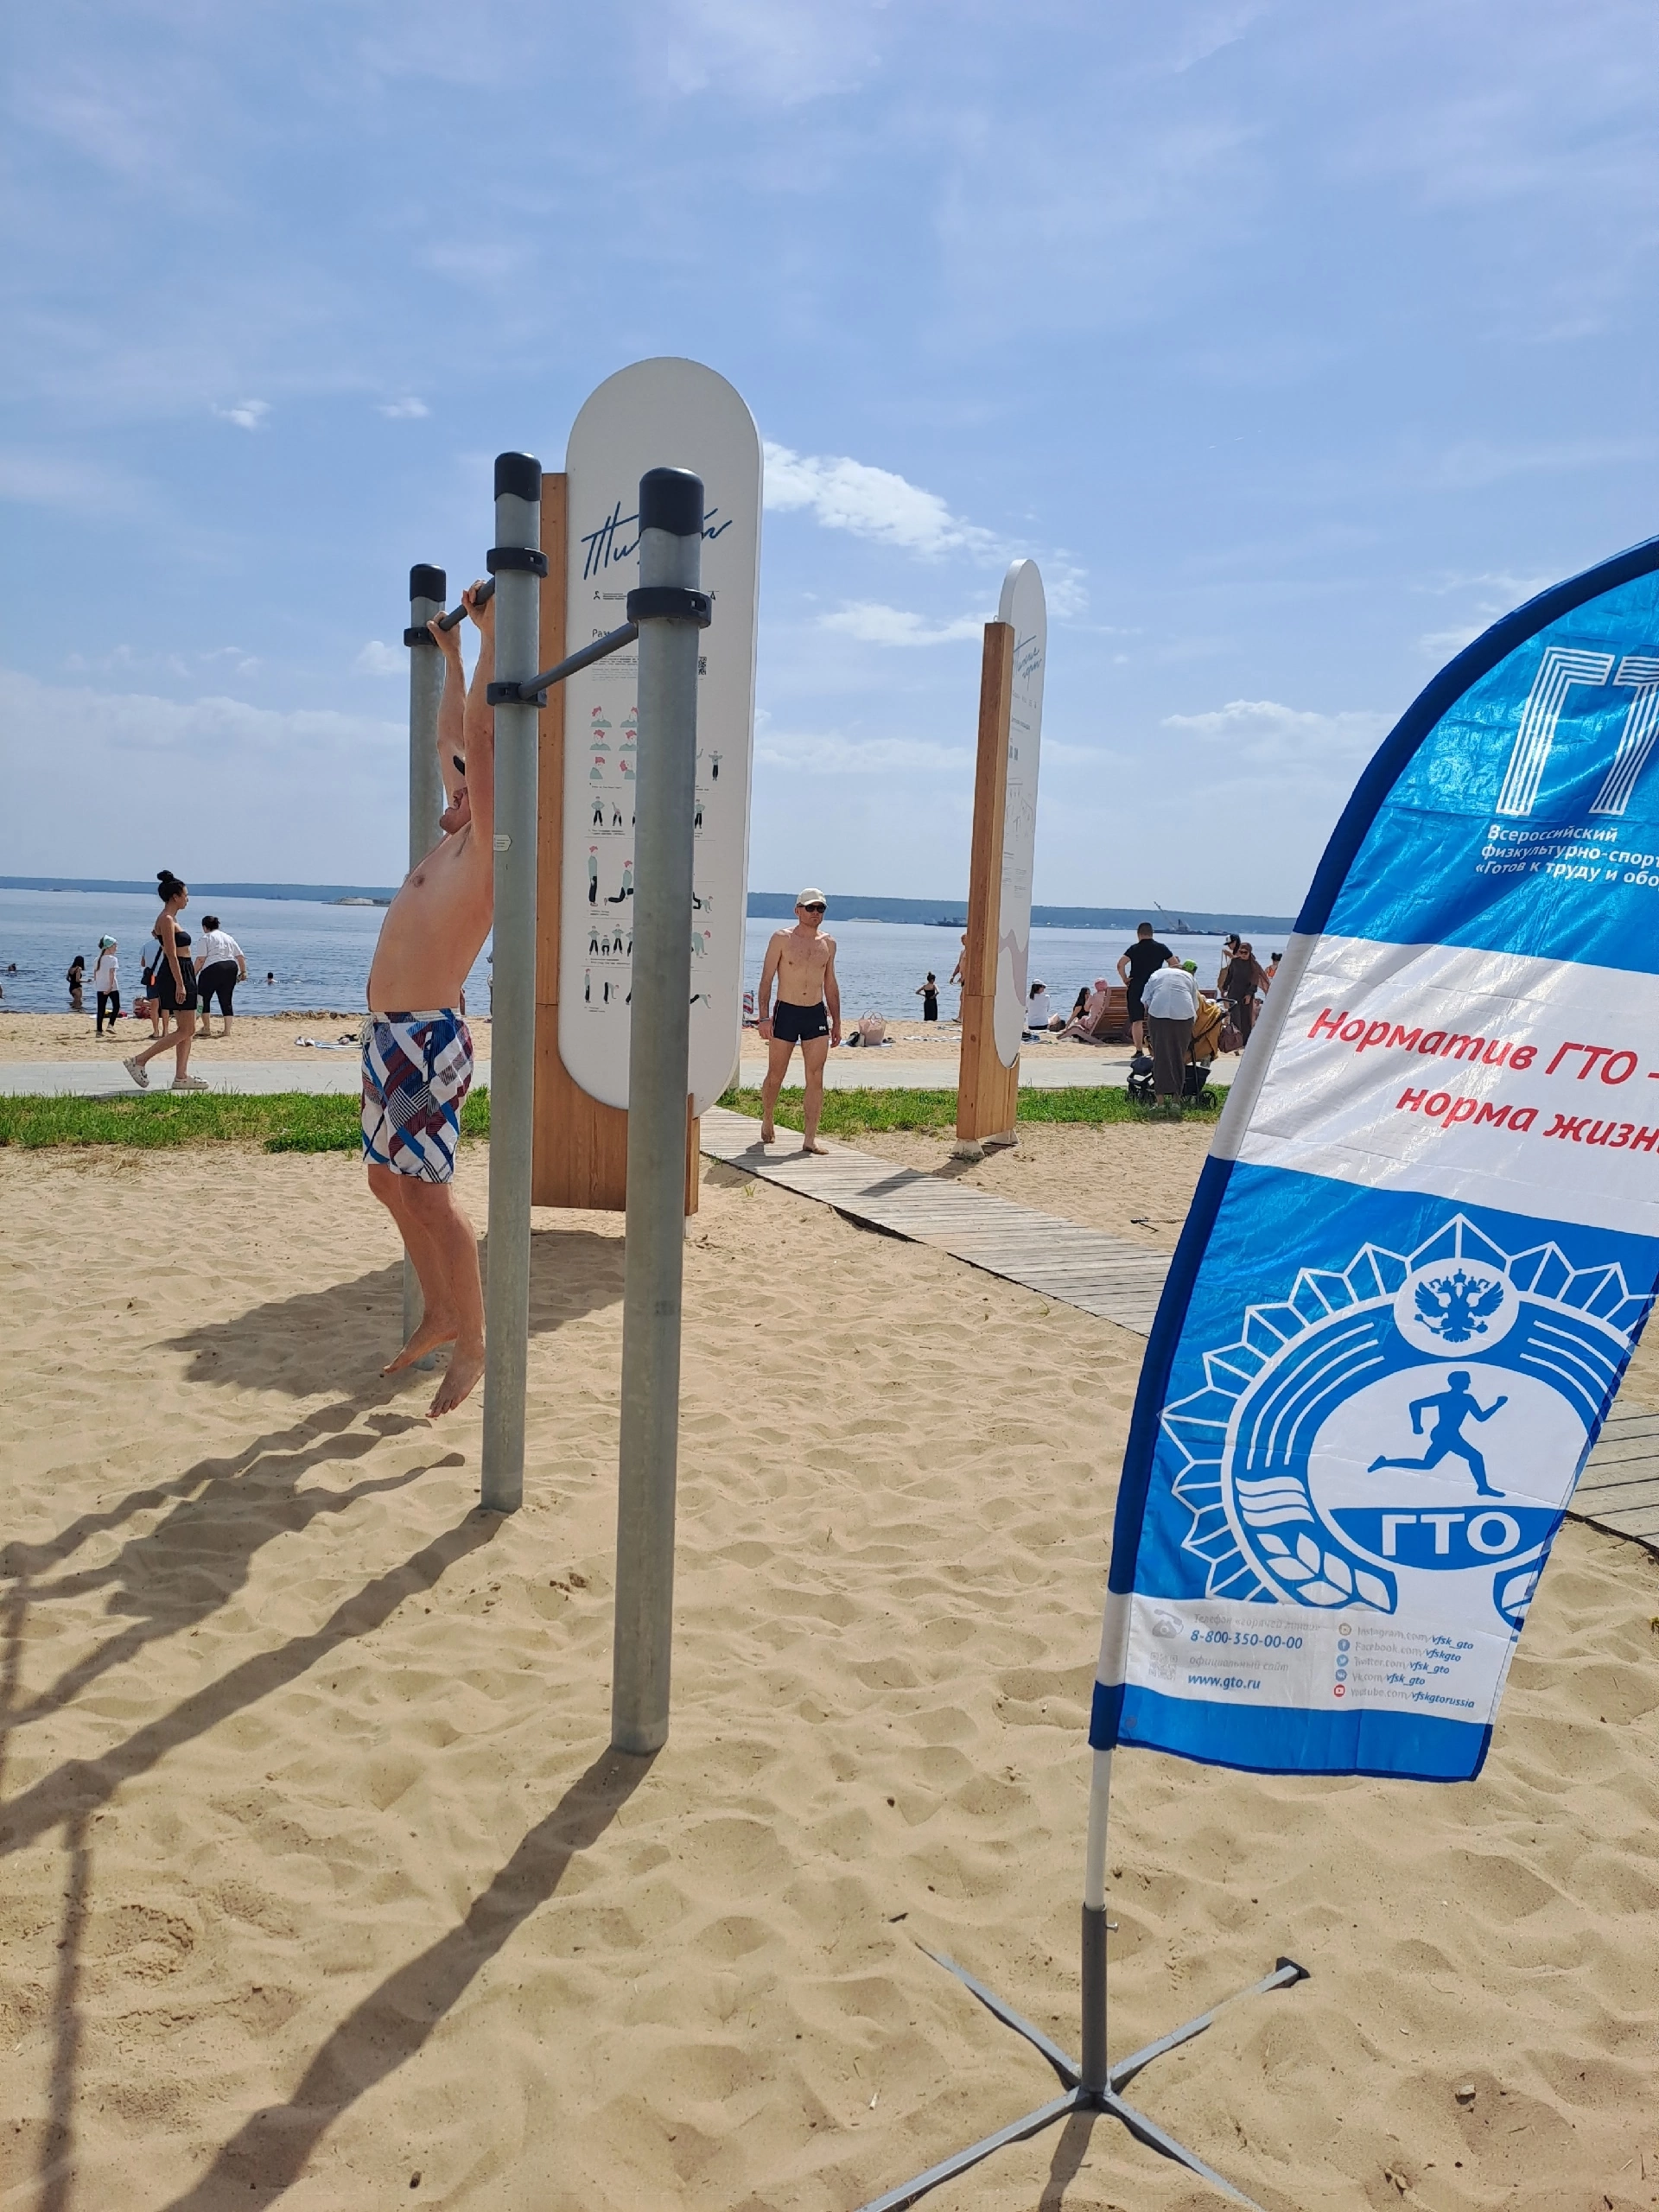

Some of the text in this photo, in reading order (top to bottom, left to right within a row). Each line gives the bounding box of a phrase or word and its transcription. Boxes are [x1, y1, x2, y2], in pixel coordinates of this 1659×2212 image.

[1487, 823, 1618, 844] Всероссийский
[1475, 861, 1659, 892] «Готов к труду и обо
[1306, 1007, 1538, 1071] Норматив
[1544, 1042, 1638, 1085] ГТО
[1395, 1086, 1659, 1154] норма жизн
[1382, 1511, 1521, 1556] ГТО
[1193, 1613, 1232, 1626] Телефон
[1190, 1630, 1303, 1649] 8-800-350-00-00
[1189, 1655, 1289, 1672] официальный сайт
[1188, 1675, 1261, 1690] www.gto.ru
